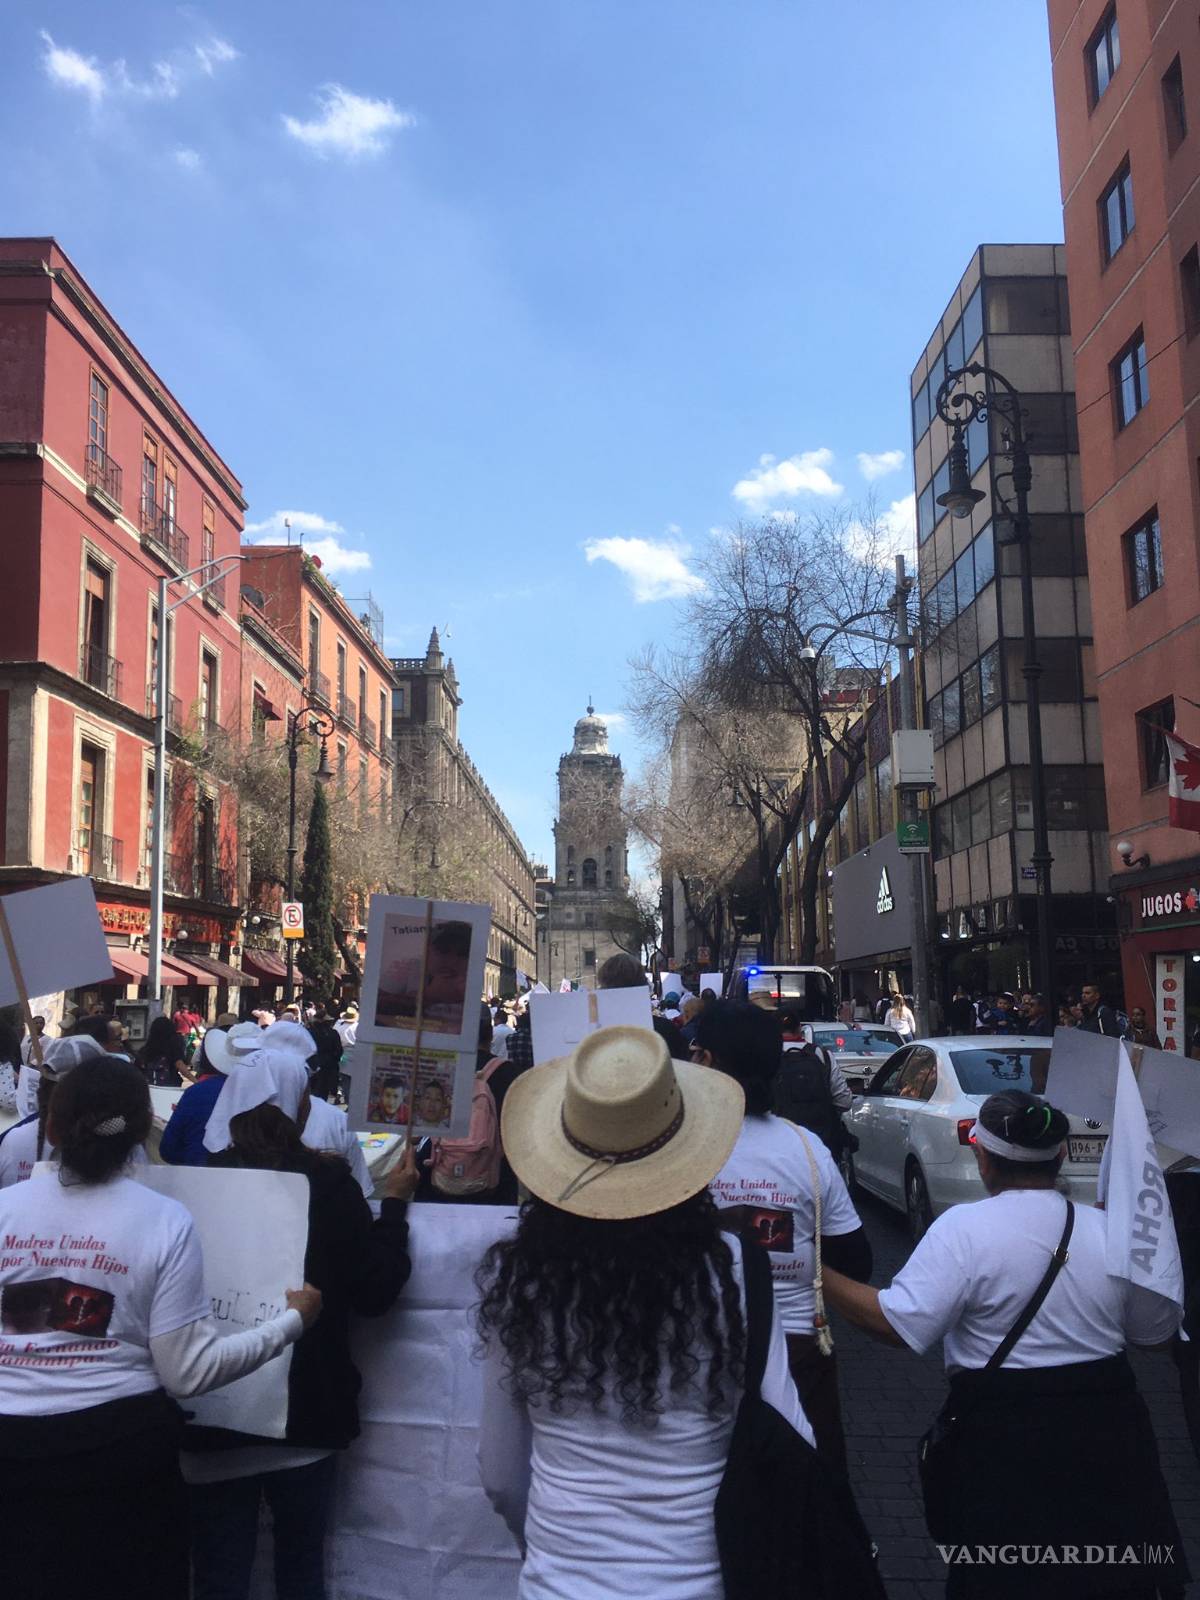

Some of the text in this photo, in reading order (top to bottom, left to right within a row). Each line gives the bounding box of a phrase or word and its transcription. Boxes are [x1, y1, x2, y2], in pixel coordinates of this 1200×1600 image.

[877, 896, 893, 914] adidas
[1142, 892, 1182, 918] JUGOS
[391, 926, 428, 935] Tatian
[1072, 1142, 1104, 1154] H96-A
[707, 1178, 778, 1190] adres Unidas
[719, 1191, 798, 1206] Nuestros Hijos
[2, 1234, 107, 1251] Madres Unidas
[0, 1251, 129, 1275] por Nuestros Hijos
